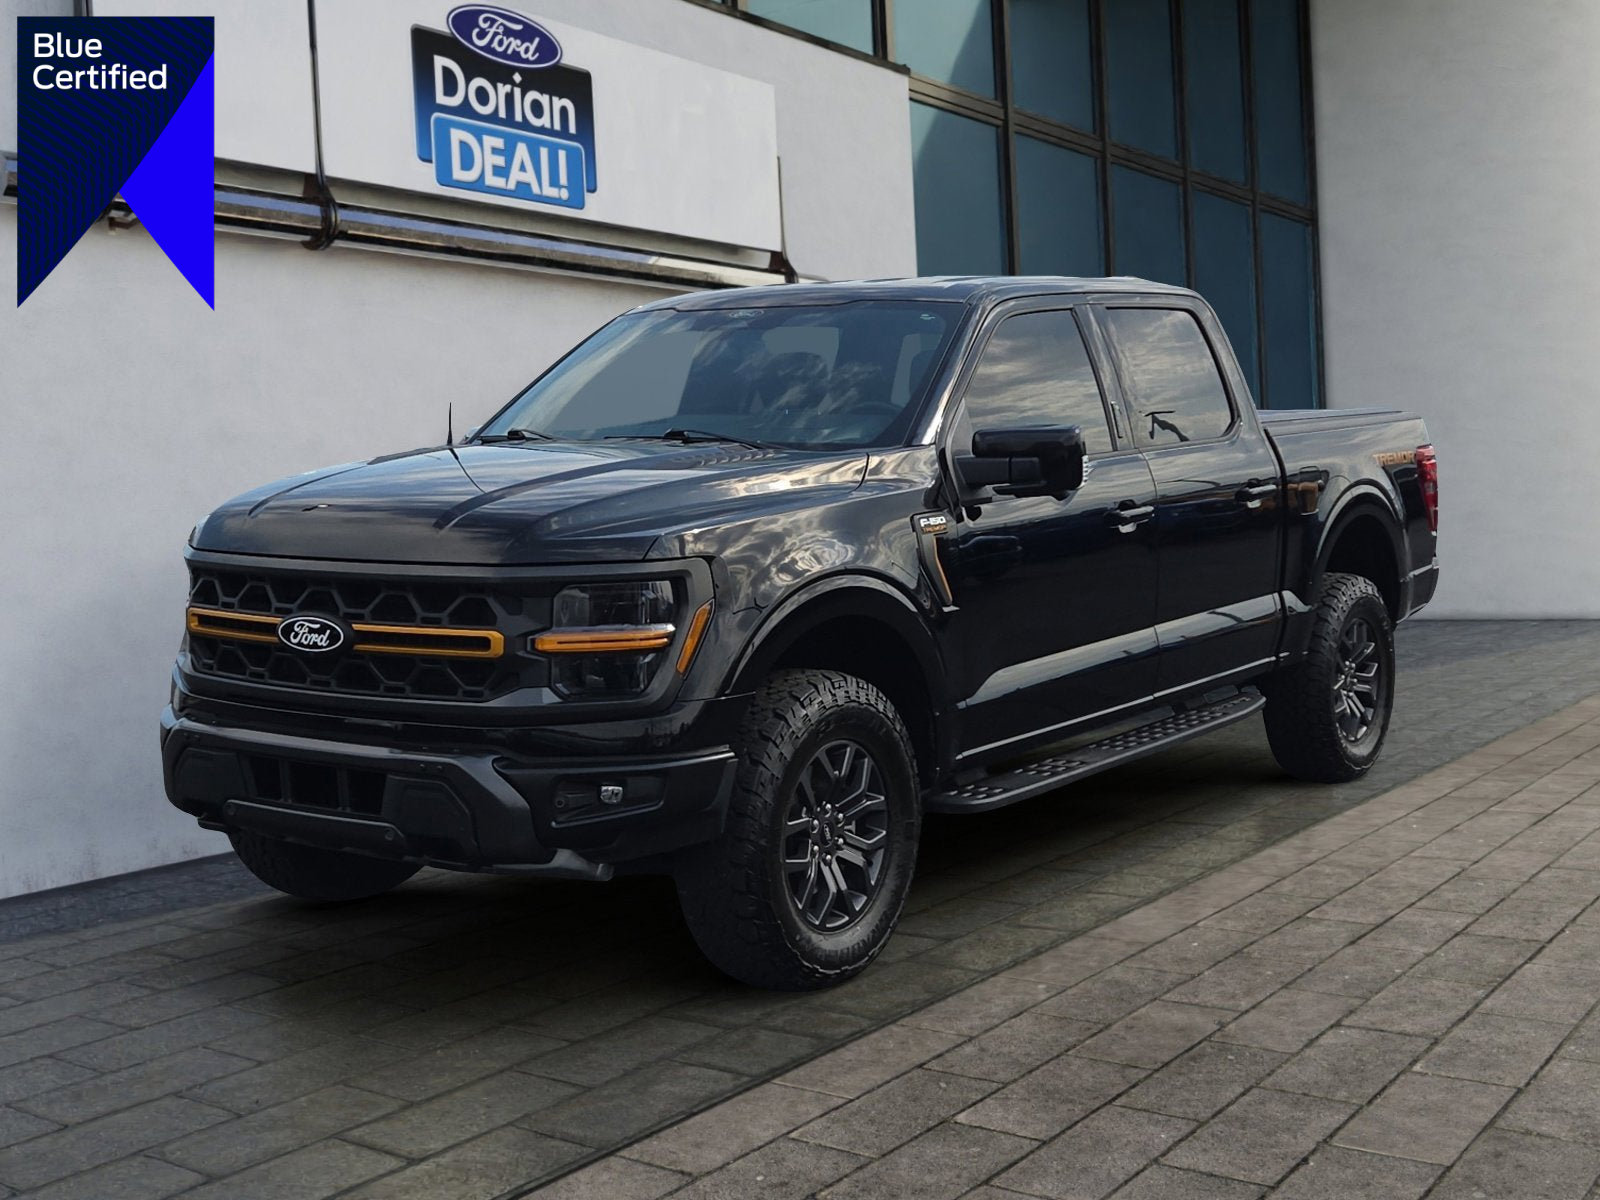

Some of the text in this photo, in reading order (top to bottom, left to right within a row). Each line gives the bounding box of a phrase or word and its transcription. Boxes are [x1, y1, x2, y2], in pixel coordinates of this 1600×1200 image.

[471, 13, 540, 61] Ford
[433, 54, 577, 135] Dorian
[450, 127, 570, 201] DEAL!
[920, 516, 947, 527] F-150
[290, 620, 331, 647] Ford
